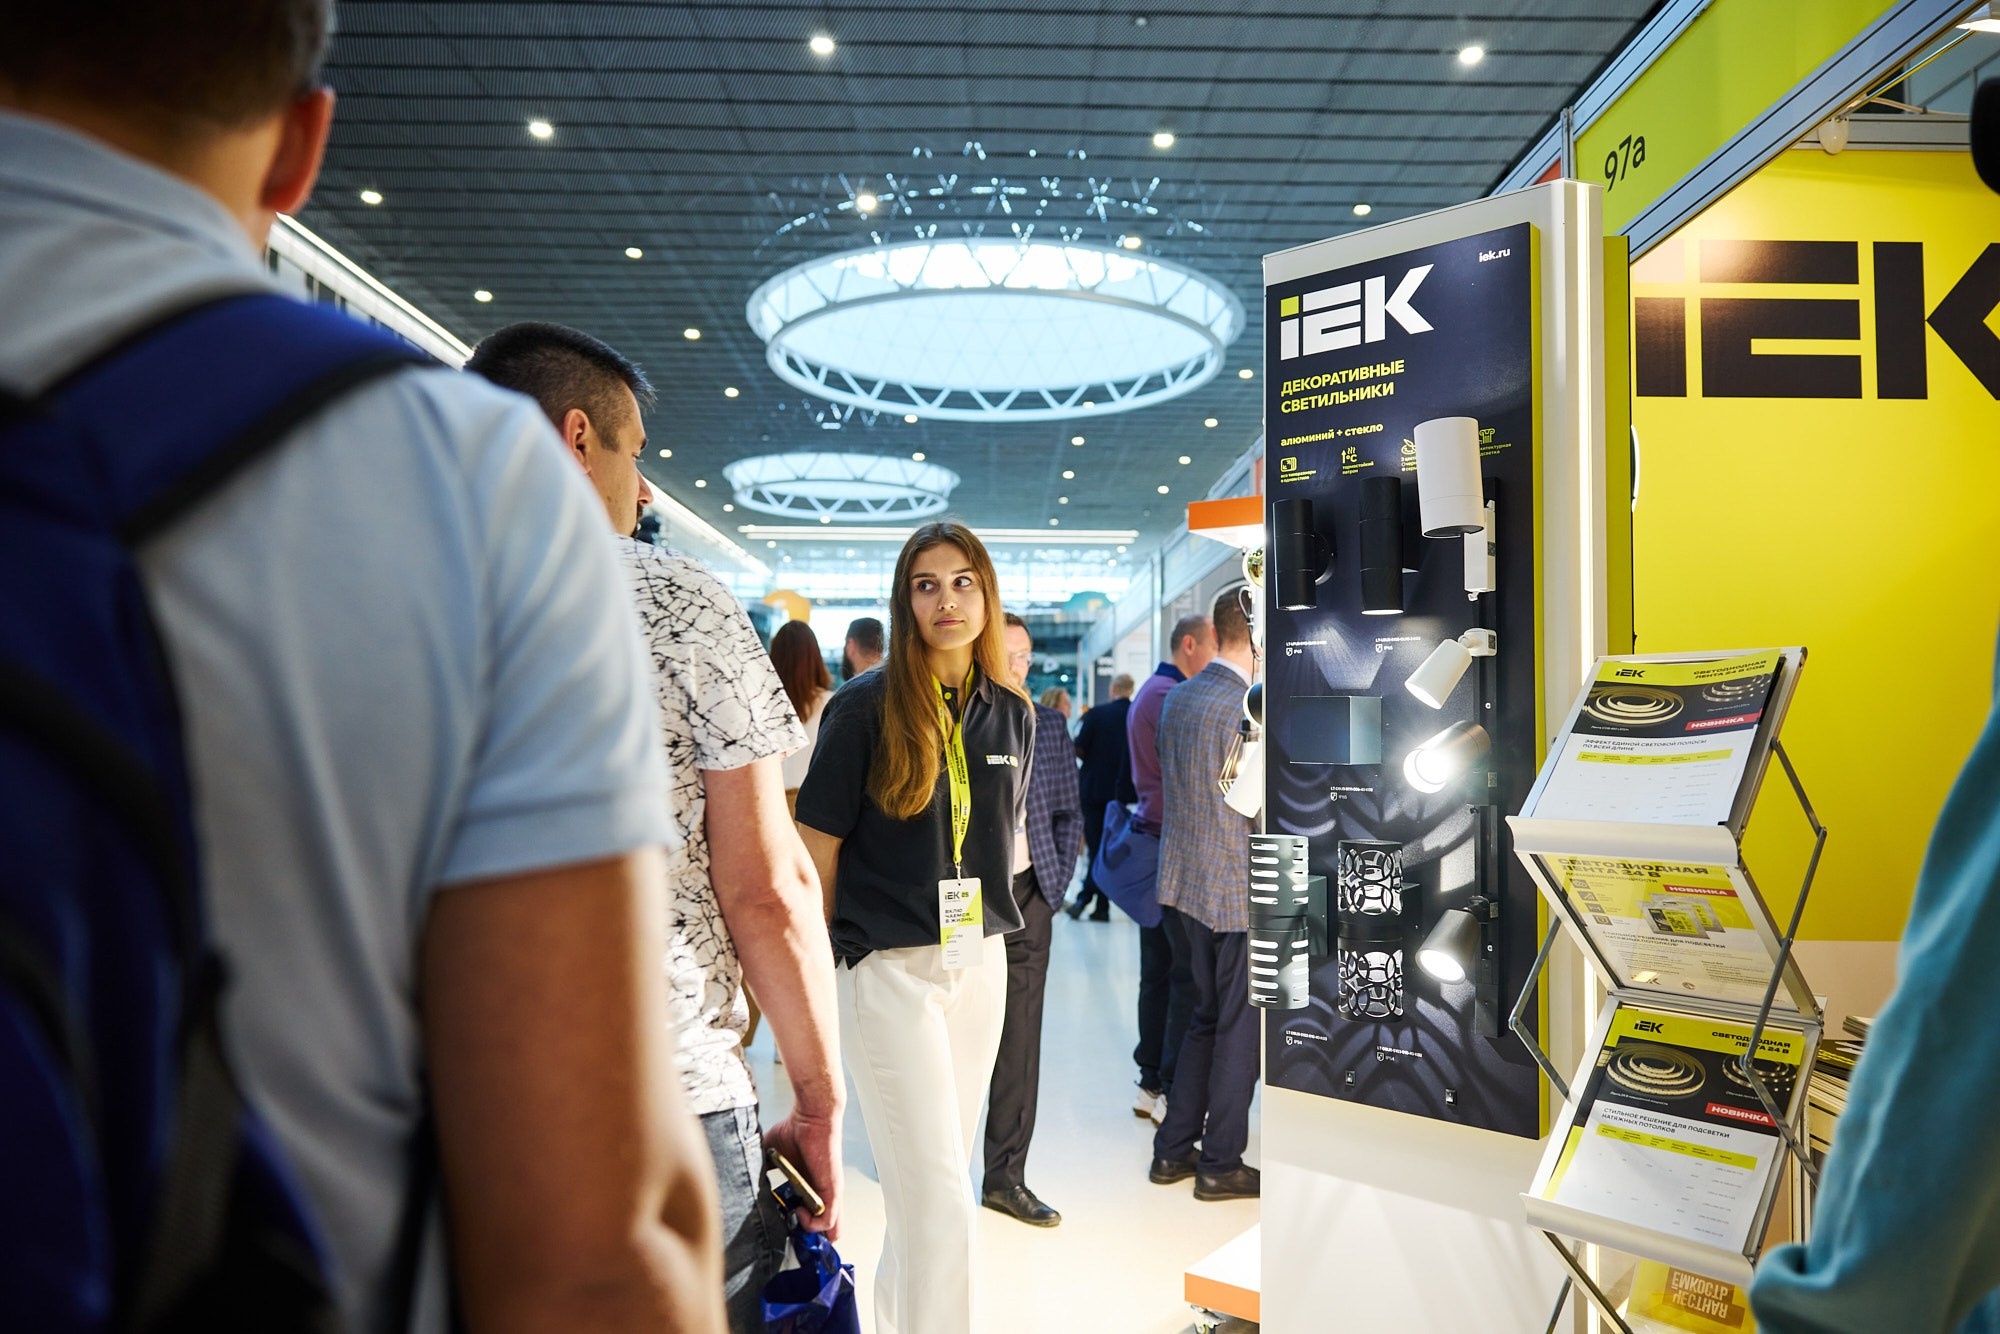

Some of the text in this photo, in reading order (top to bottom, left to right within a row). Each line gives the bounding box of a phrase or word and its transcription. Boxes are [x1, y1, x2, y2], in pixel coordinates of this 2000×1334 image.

[1478, 248, 1511, 262] iek.ru
[1280, 359, 1405, 397] ДЕКОРАТИВНЫЕ
[1280, 381, 1395, 414] СВЕТИЛЬНИКИ
[1280, 423, 1384, 447] алюминий + стекло
[1693, 660, 1767, 675] СВЕТОДИОДНАЯ
[1691, 717, 1744, 728] НОВИНКА
[1557, 858, 1709, 875] СВЕТОДИОДНАЯ
[1562, 864, 1619, 875] ЛЕНТА
[1622, 869, 1643, 877] 24
[1668, 886, 1728, 895] НОВИНКА
[1685, 940, 1726, 949] ПОДСВЕТКИ
[1711, 1031, 1791, 1048] СВЕТОДОДНАЯ
[1711, 1106, 1769, 1122] НОВИНКА
[1601, 1113, 1676, 1133] НАТЯЖНЫХ ПОТОЛКОВ
[1604, 1108, 1638, 1119] СТИЛЬНОЕ
[1639, 1115, 1672, 1126] РЕШЕНИЕ
[1688, 1125, 1730, 1138] ПОДСВЕТКИ
